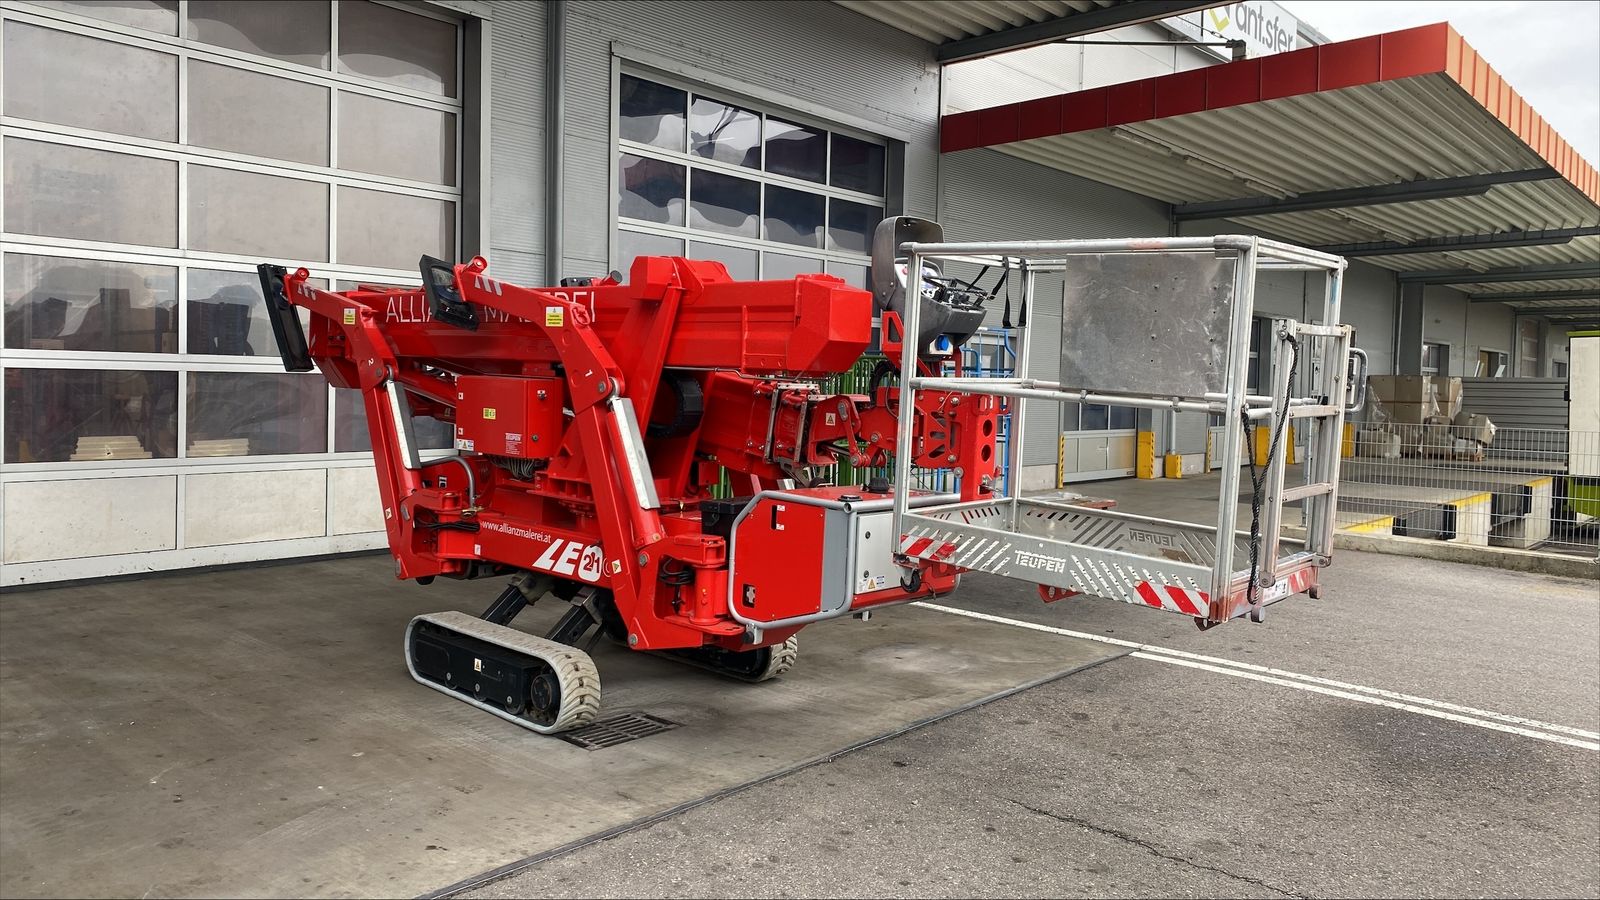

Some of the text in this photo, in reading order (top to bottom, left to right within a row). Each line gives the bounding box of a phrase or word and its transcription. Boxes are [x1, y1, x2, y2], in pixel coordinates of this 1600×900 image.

[1235, 3, 1293, 52] ant.sfer
[481, 520, 551, 544] www.allianzmalerei.at
[532, 538, 603, 582] LEO
[1014, 550, 1066, 574] TEUPEN
